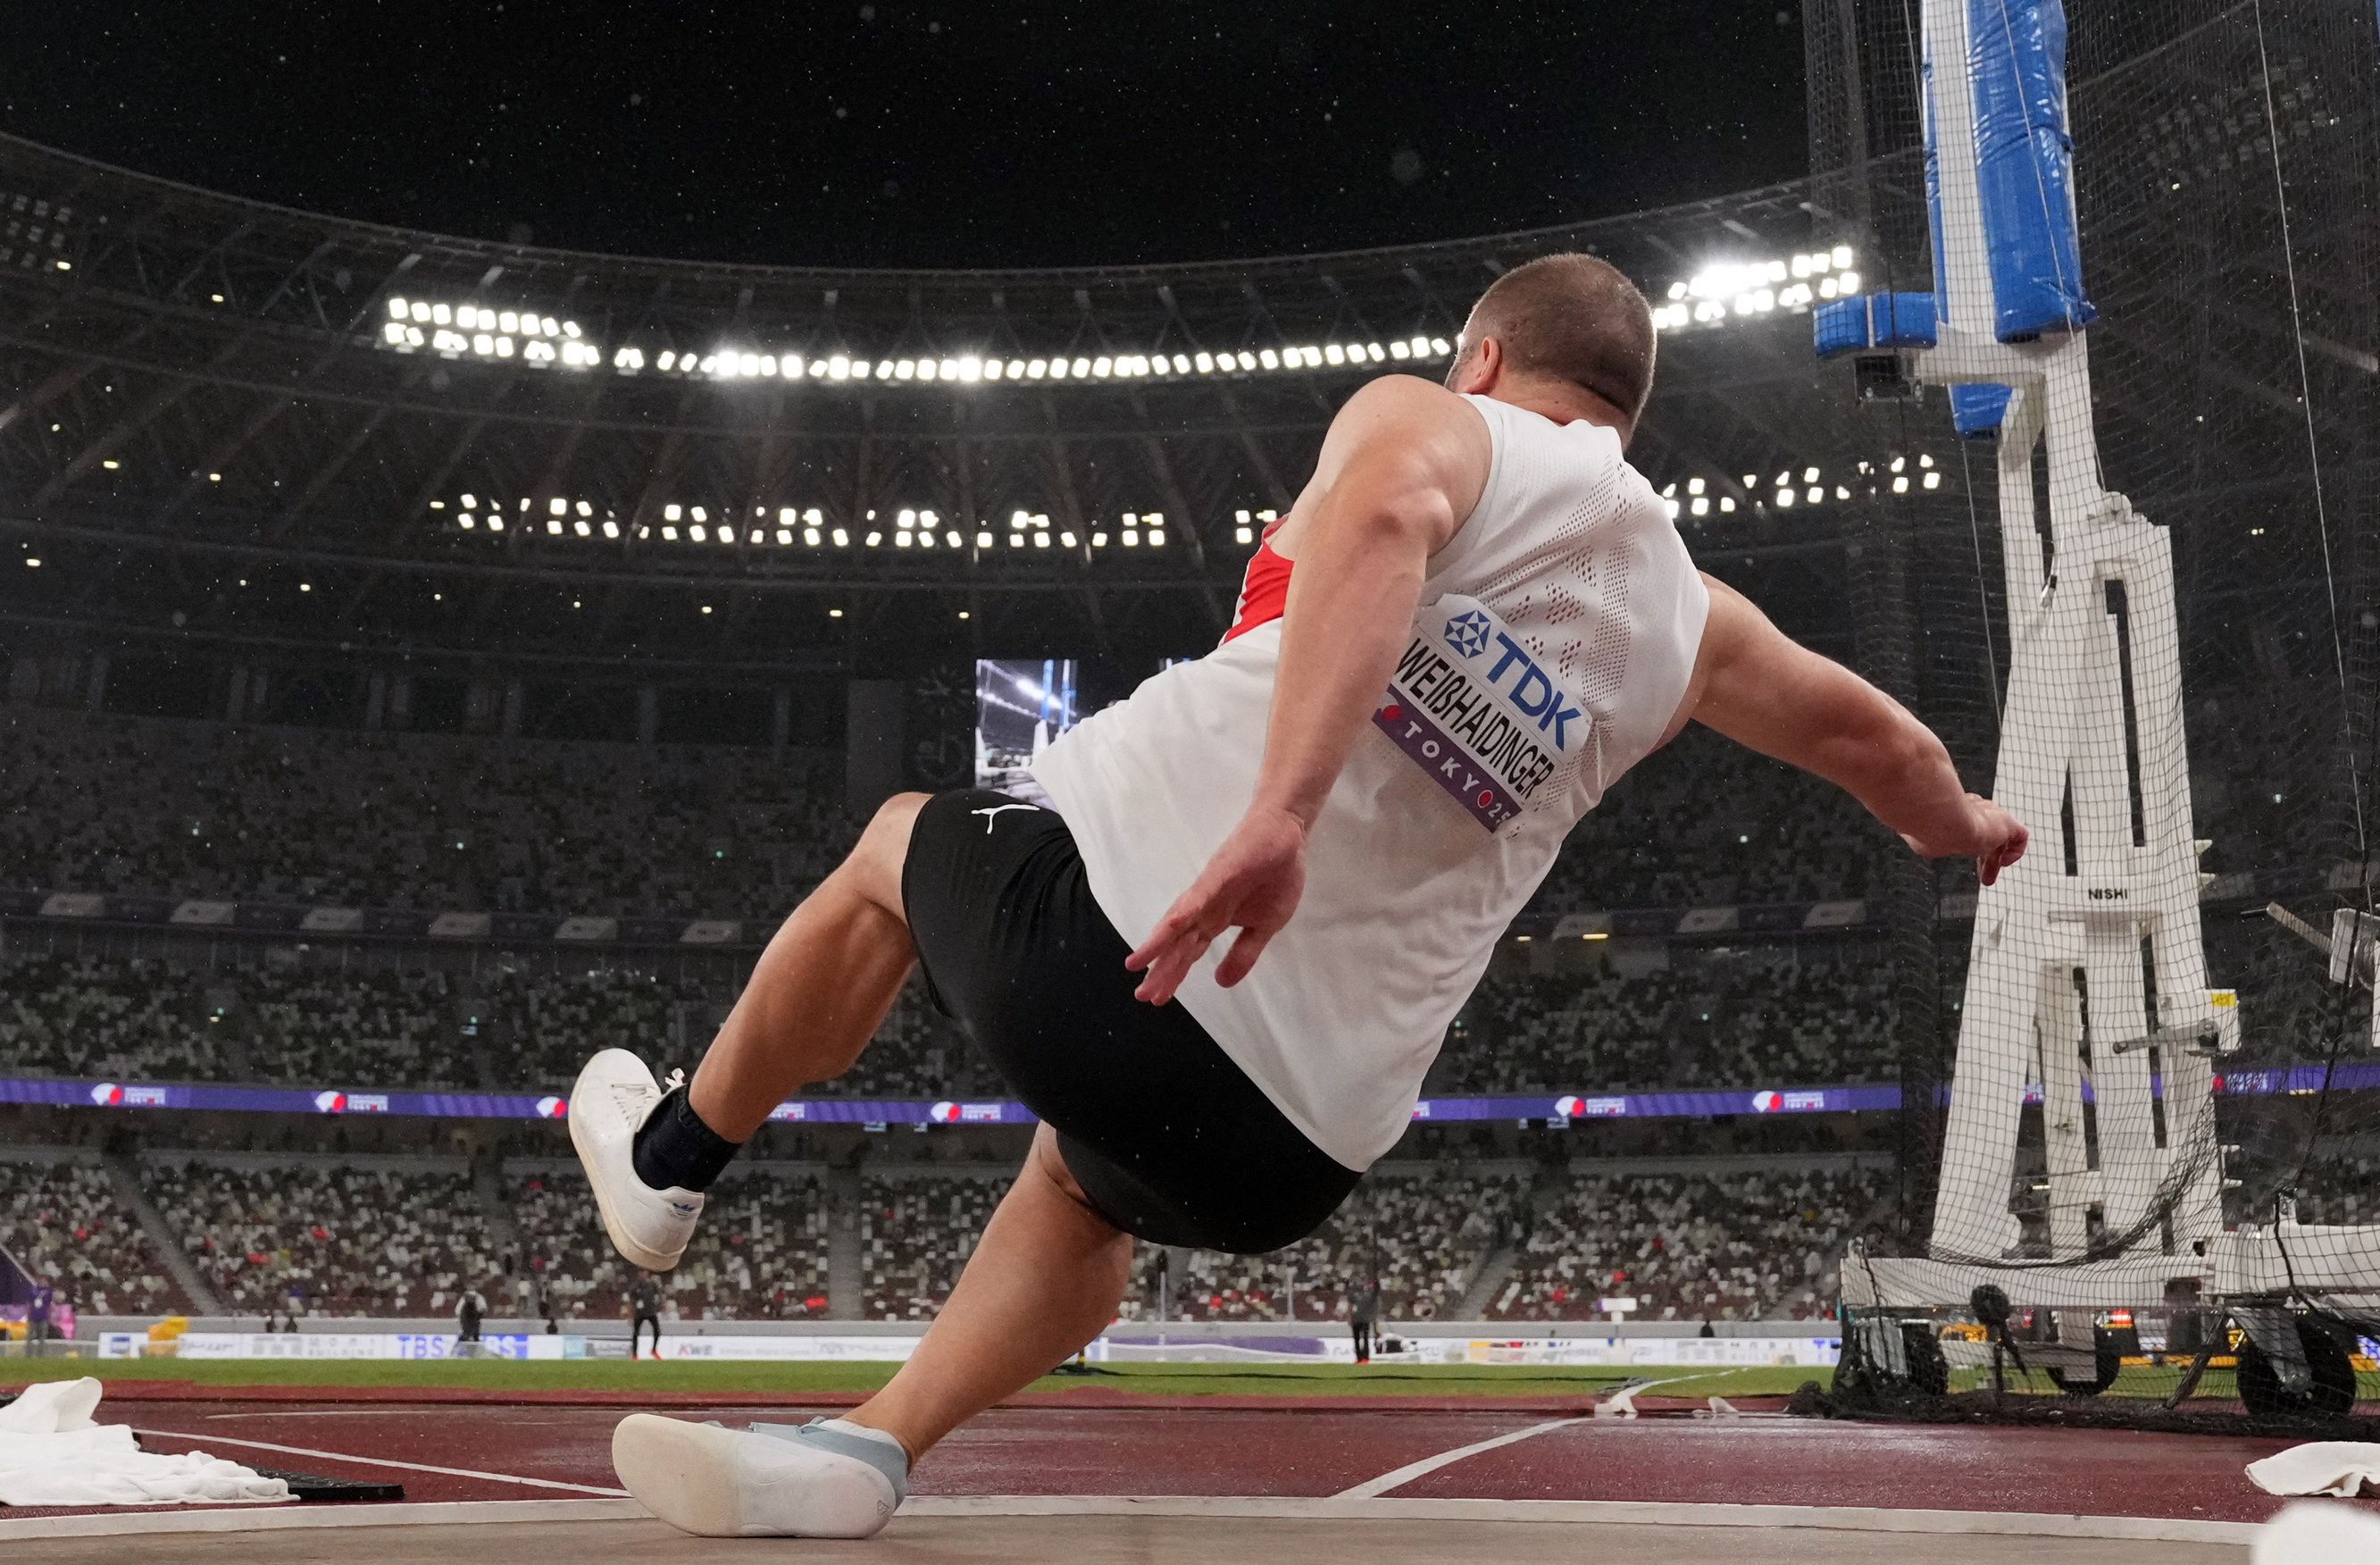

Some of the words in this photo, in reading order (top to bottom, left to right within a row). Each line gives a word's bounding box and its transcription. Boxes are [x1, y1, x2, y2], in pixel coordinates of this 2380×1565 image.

[1486, 631, 1582, 752] TDK
[1403, 720, 1493, 808] TOKYO
[2088, 887, 2128, 900] NISHI
[398, 1335, 444, 1359] TBS
